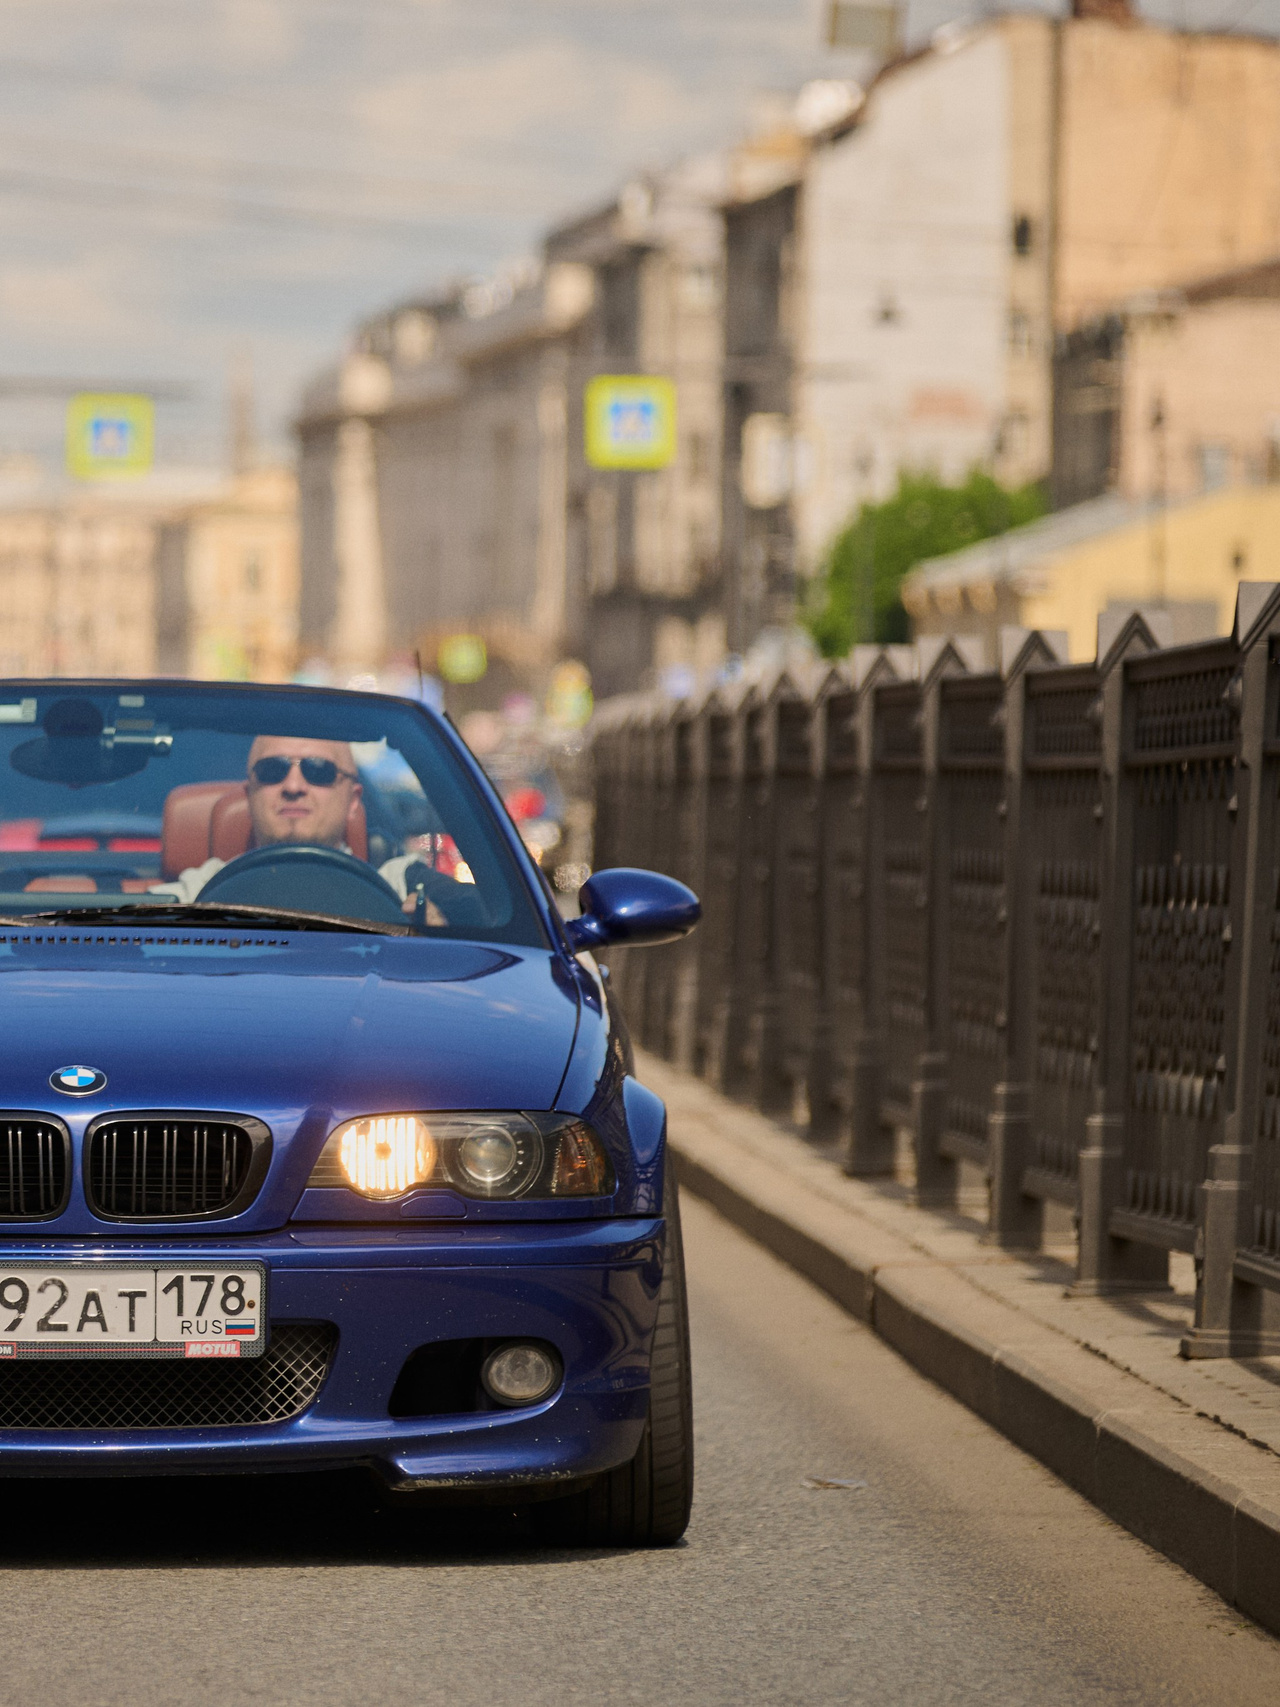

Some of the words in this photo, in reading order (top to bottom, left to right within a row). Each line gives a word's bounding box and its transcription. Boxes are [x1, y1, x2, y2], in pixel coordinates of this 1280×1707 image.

[162, 1274, 246, 1317] 178
[181, 1319, 223, 1335] RUS
[187, 1343, 238, 1355] MOTUL
